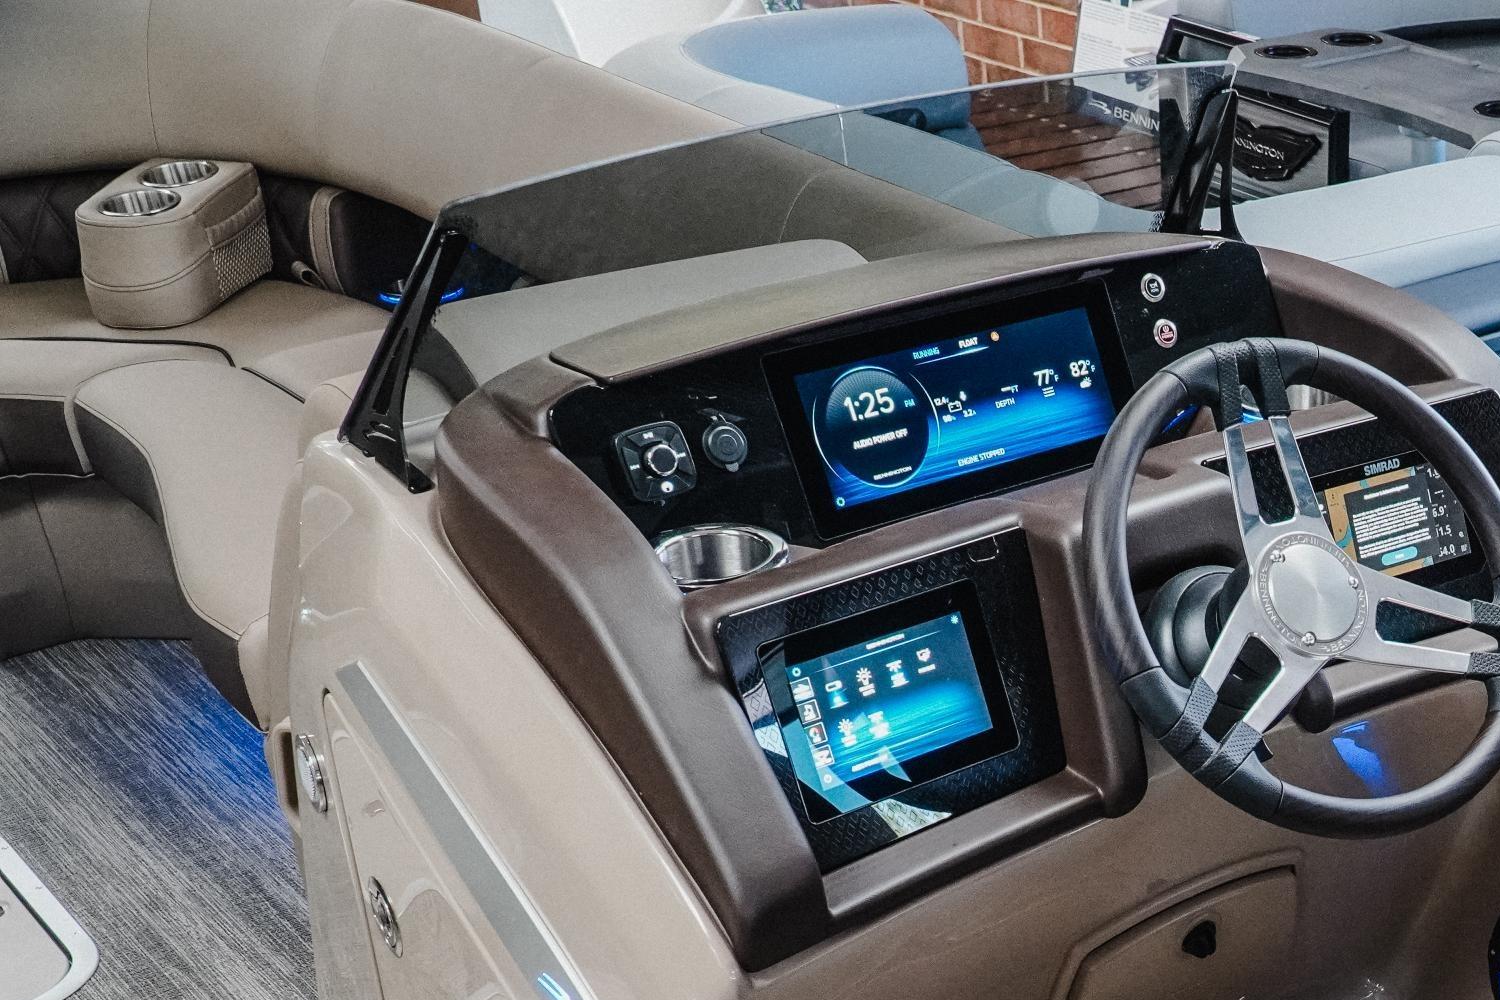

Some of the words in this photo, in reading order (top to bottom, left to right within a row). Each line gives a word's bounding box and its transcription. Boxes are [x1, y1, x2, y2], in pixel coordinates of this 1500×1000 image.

[958, 336, 978, 348] FLOAT
[843, 387, 895, 421] 1:25
[994, 397, 1016, 409] DEPTH
[853, 437, 874, 450] AUDIO
[872, 431, 897, 445] POWER
[895, 427, 908, 439] OFF
[957, 454, 980, 467] ENGINE
[978, 447, 1006, 461] STOPPED
[1363, 457, 1401, 476] SIMRAD
